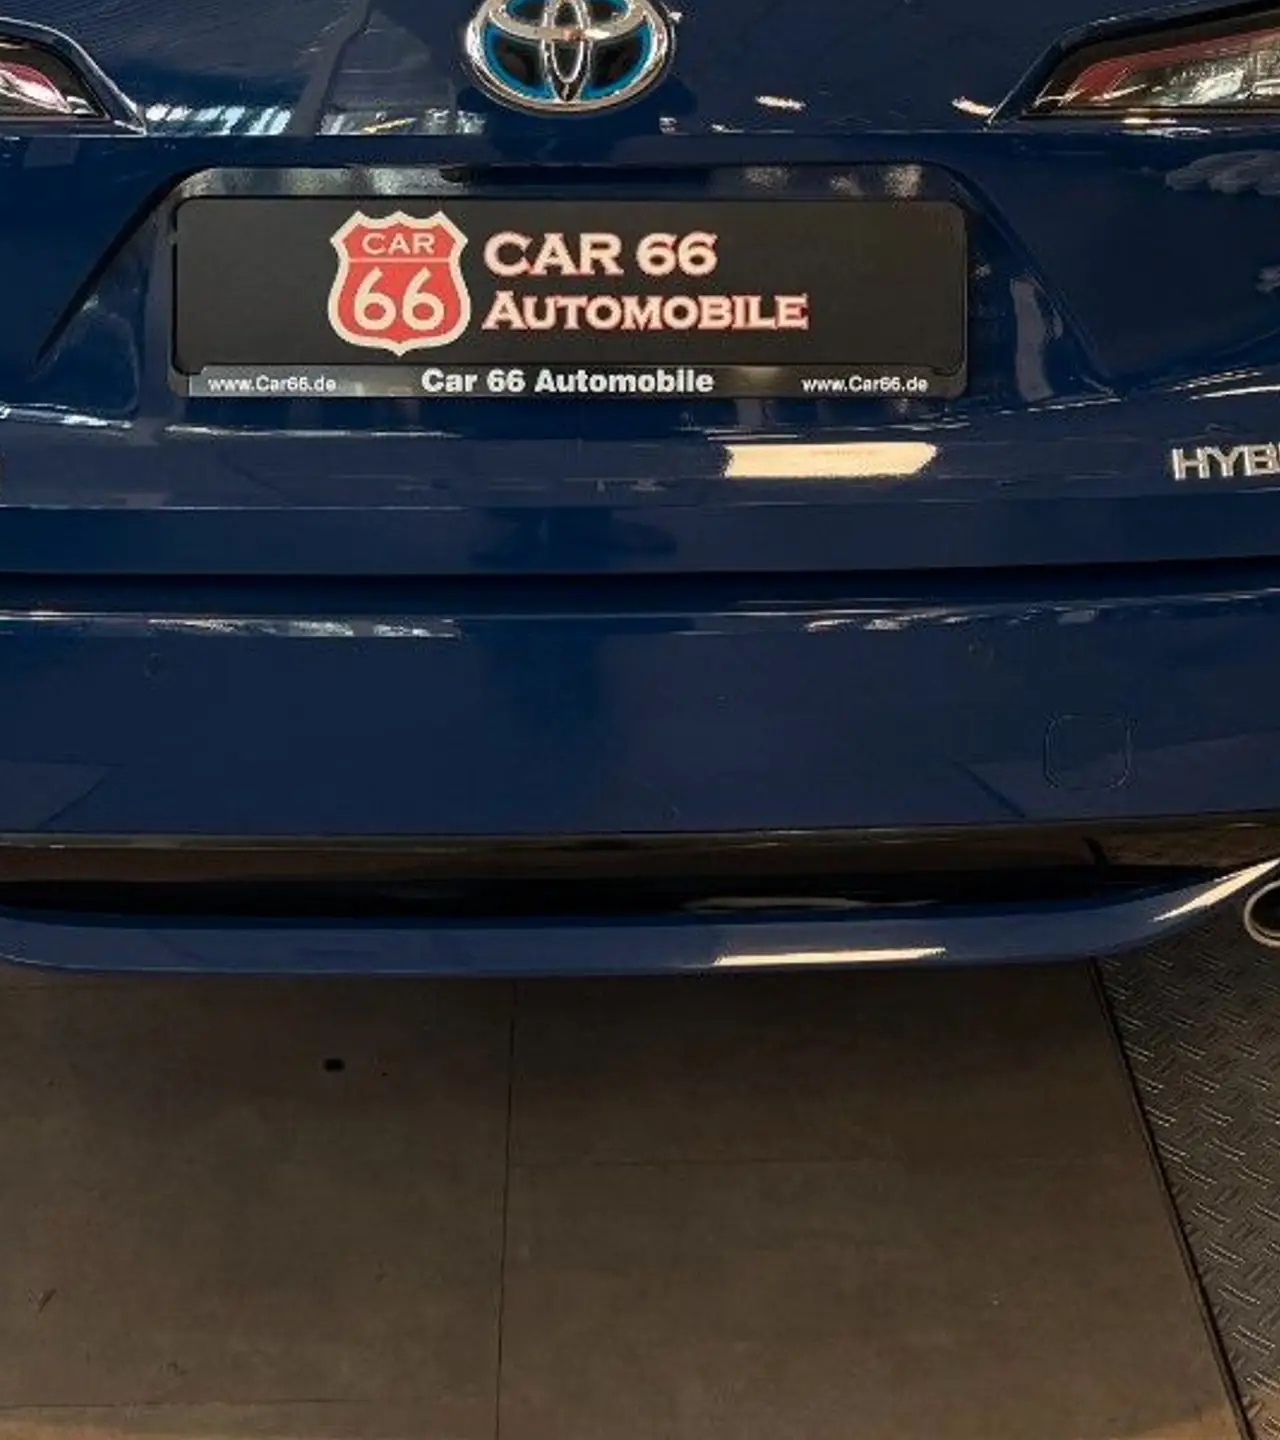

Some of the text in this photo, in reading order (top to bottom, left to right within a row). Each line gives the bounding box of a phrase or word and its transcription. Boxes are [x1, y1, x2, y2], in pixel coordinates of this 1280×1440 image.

[362, 232, 435, 255] CAR
[483, 230, 718, 277] CAR 66
[353, 266, 444, 330] 66
[207, 375, 336, 393] www.Car66.de
[421, 368, 715, 394] Car 66 Automobile
[801, 375, 929, 393] www.Car66.de
